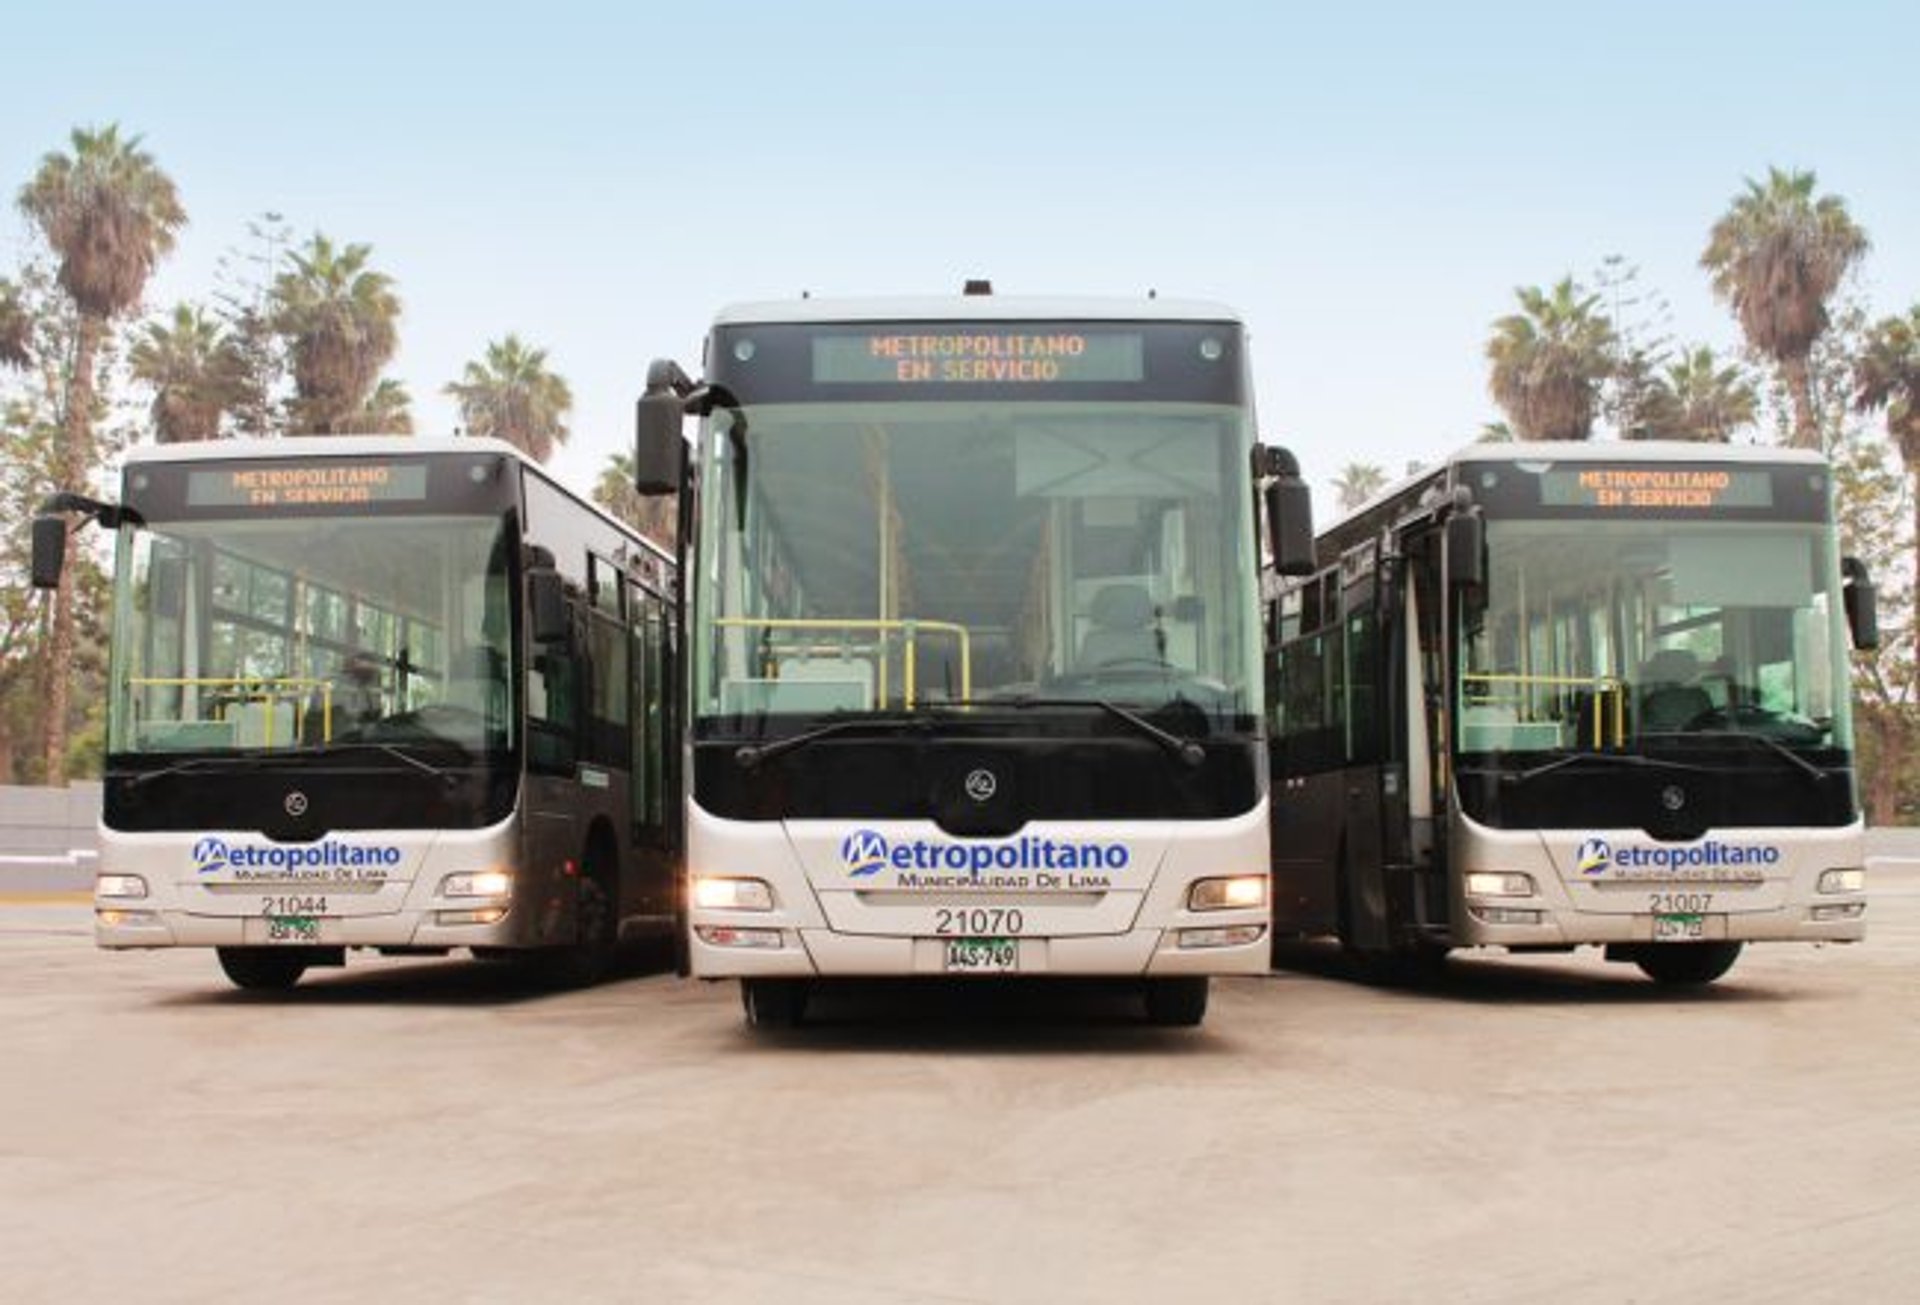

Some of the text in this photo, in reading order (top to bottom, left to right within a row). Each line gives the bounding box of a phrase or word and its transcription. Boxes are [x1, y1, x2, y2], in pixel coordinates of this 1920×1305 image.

[872, 336, 1085, 356] METROPOLITANO
[898, 361, 1058, 380] EN SERVICIO
[233, 467, 388, 488] METROPOLITANO
[1579, 471, 1729, 490] METROPOLITANO
[251, 490, 276, 504] EN
[1596, 490, 1712, 507] EN SERVICIO
[193, 838, 401, 873] Metropolitano
[842, 829, 1129, 877] Metropolitano
[262, 896, 328, 916] 21044
[1649, 894, 1714, 913] 21007
[935, 908, 1023, 934] 21070
